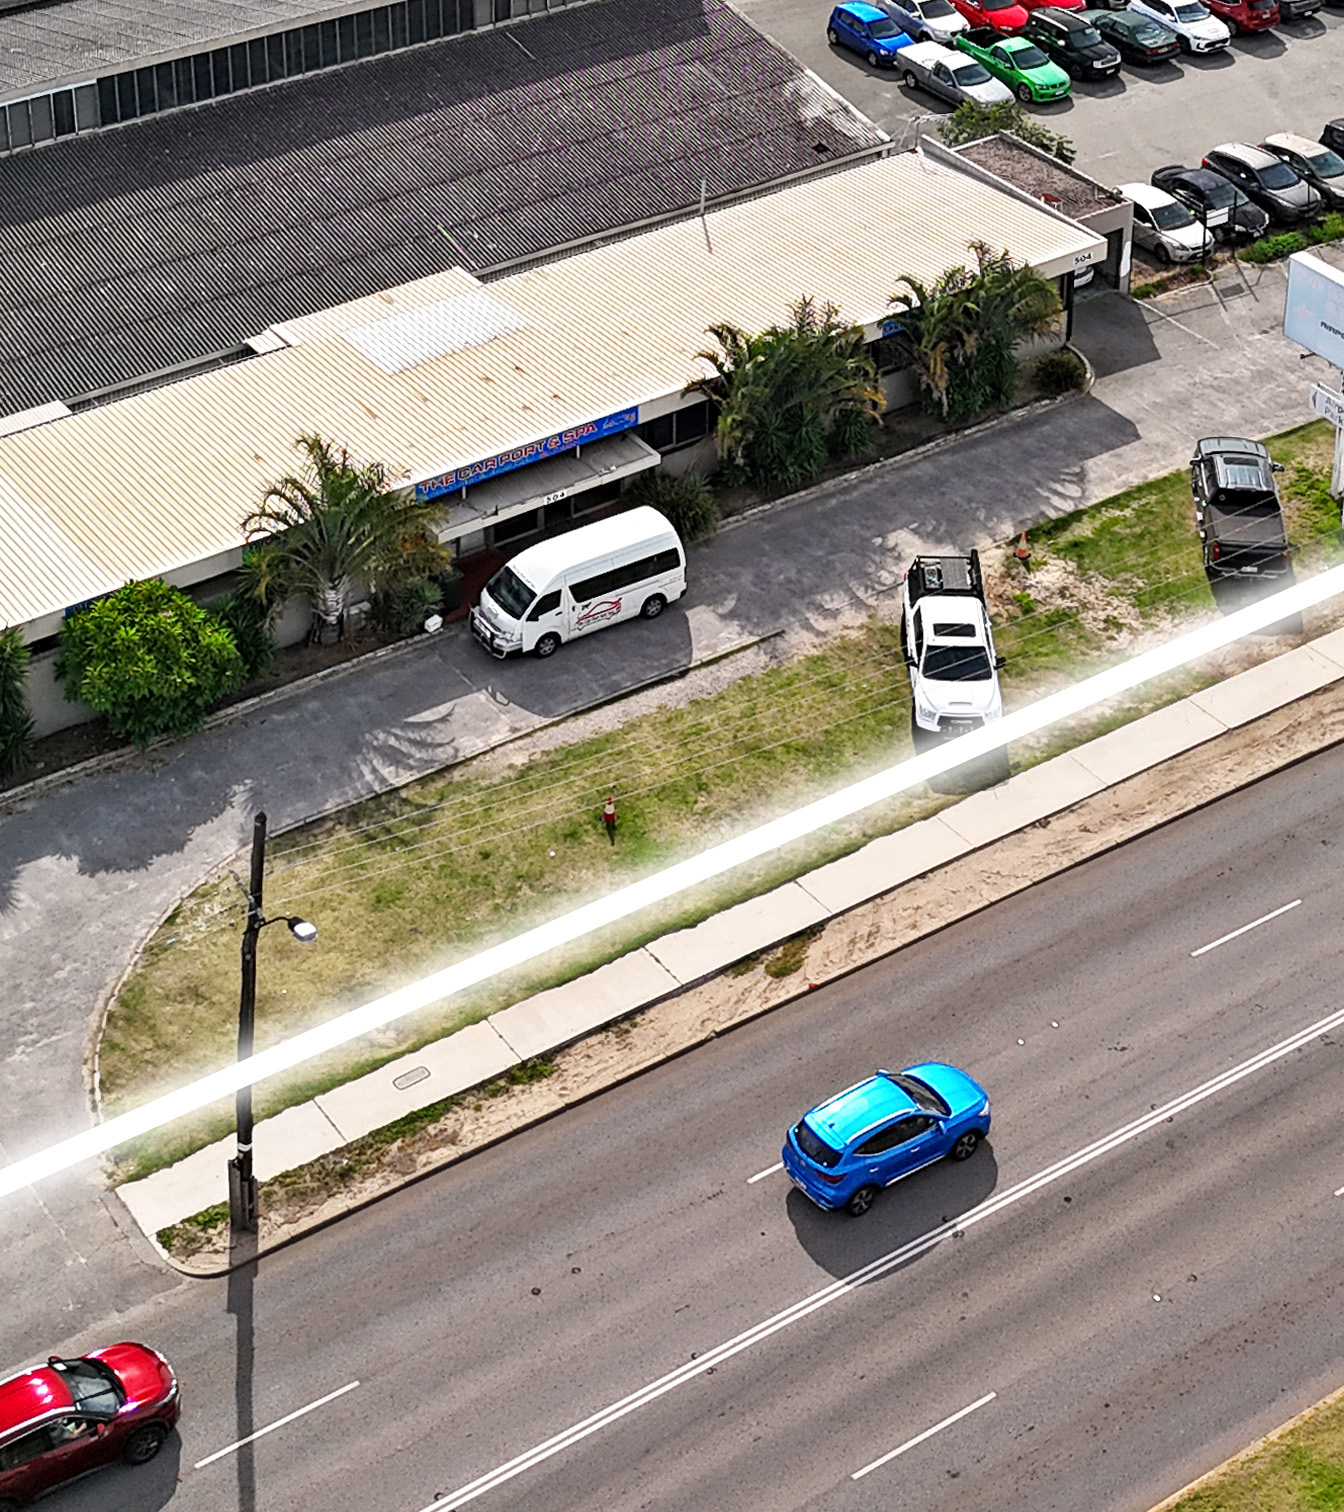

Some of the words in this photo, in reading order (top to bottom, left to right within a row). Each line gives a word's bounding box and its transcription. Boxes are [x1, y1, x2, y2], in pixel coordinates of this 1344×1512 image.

[1074, 252, 1092, 265] 504
[418, 475, 455, 494] THE
[457, 458, 496, 479] CAR
[499, 440, 546, 466] PORT
[547, 435, 561, 449] &
[562, 423, 597, 442] SPA
